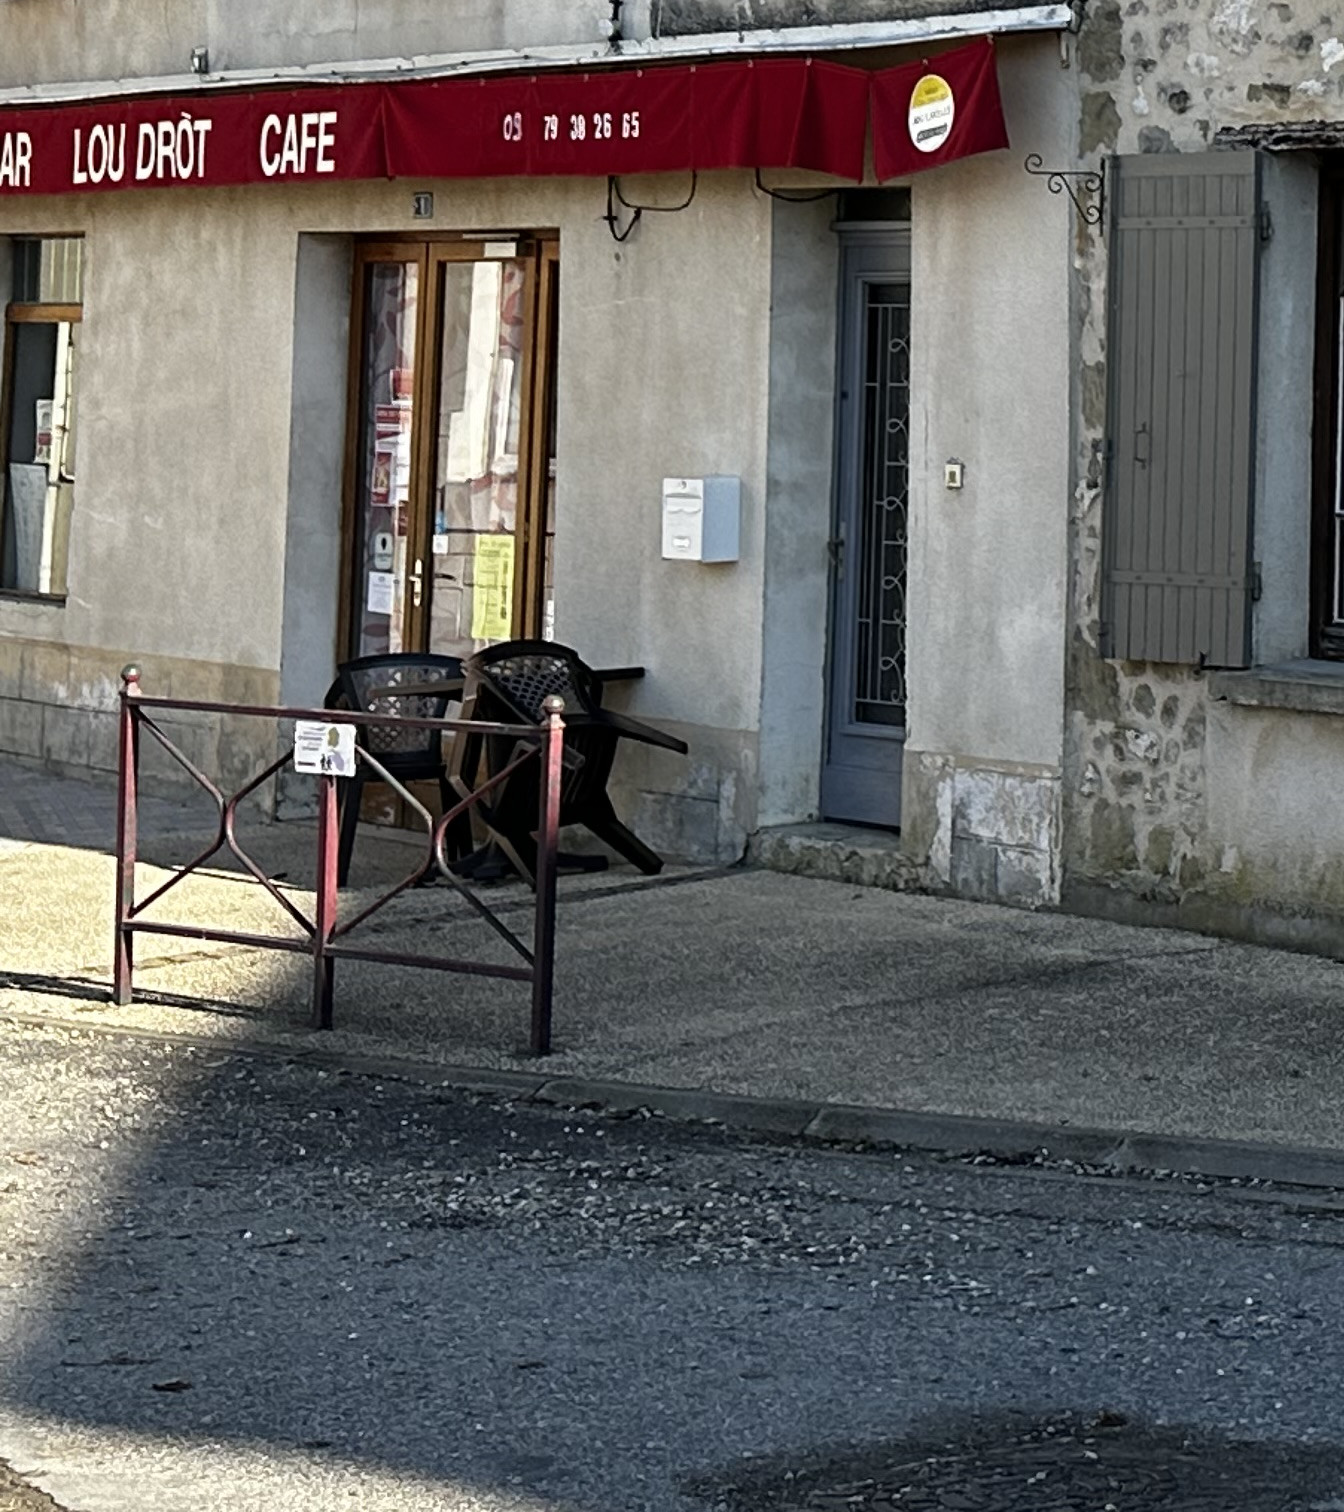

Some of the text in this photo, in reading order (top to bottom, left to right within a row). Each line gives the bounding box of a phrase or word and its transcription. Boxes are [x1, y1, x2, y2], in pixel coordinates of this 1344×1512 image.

[0, 111, 338, 187] AR LOU DRÒT CAFE
[543, 114, 559, 141] 79
[593, 112, 612, 139] 26
[621, 111, 640, 139] 65
